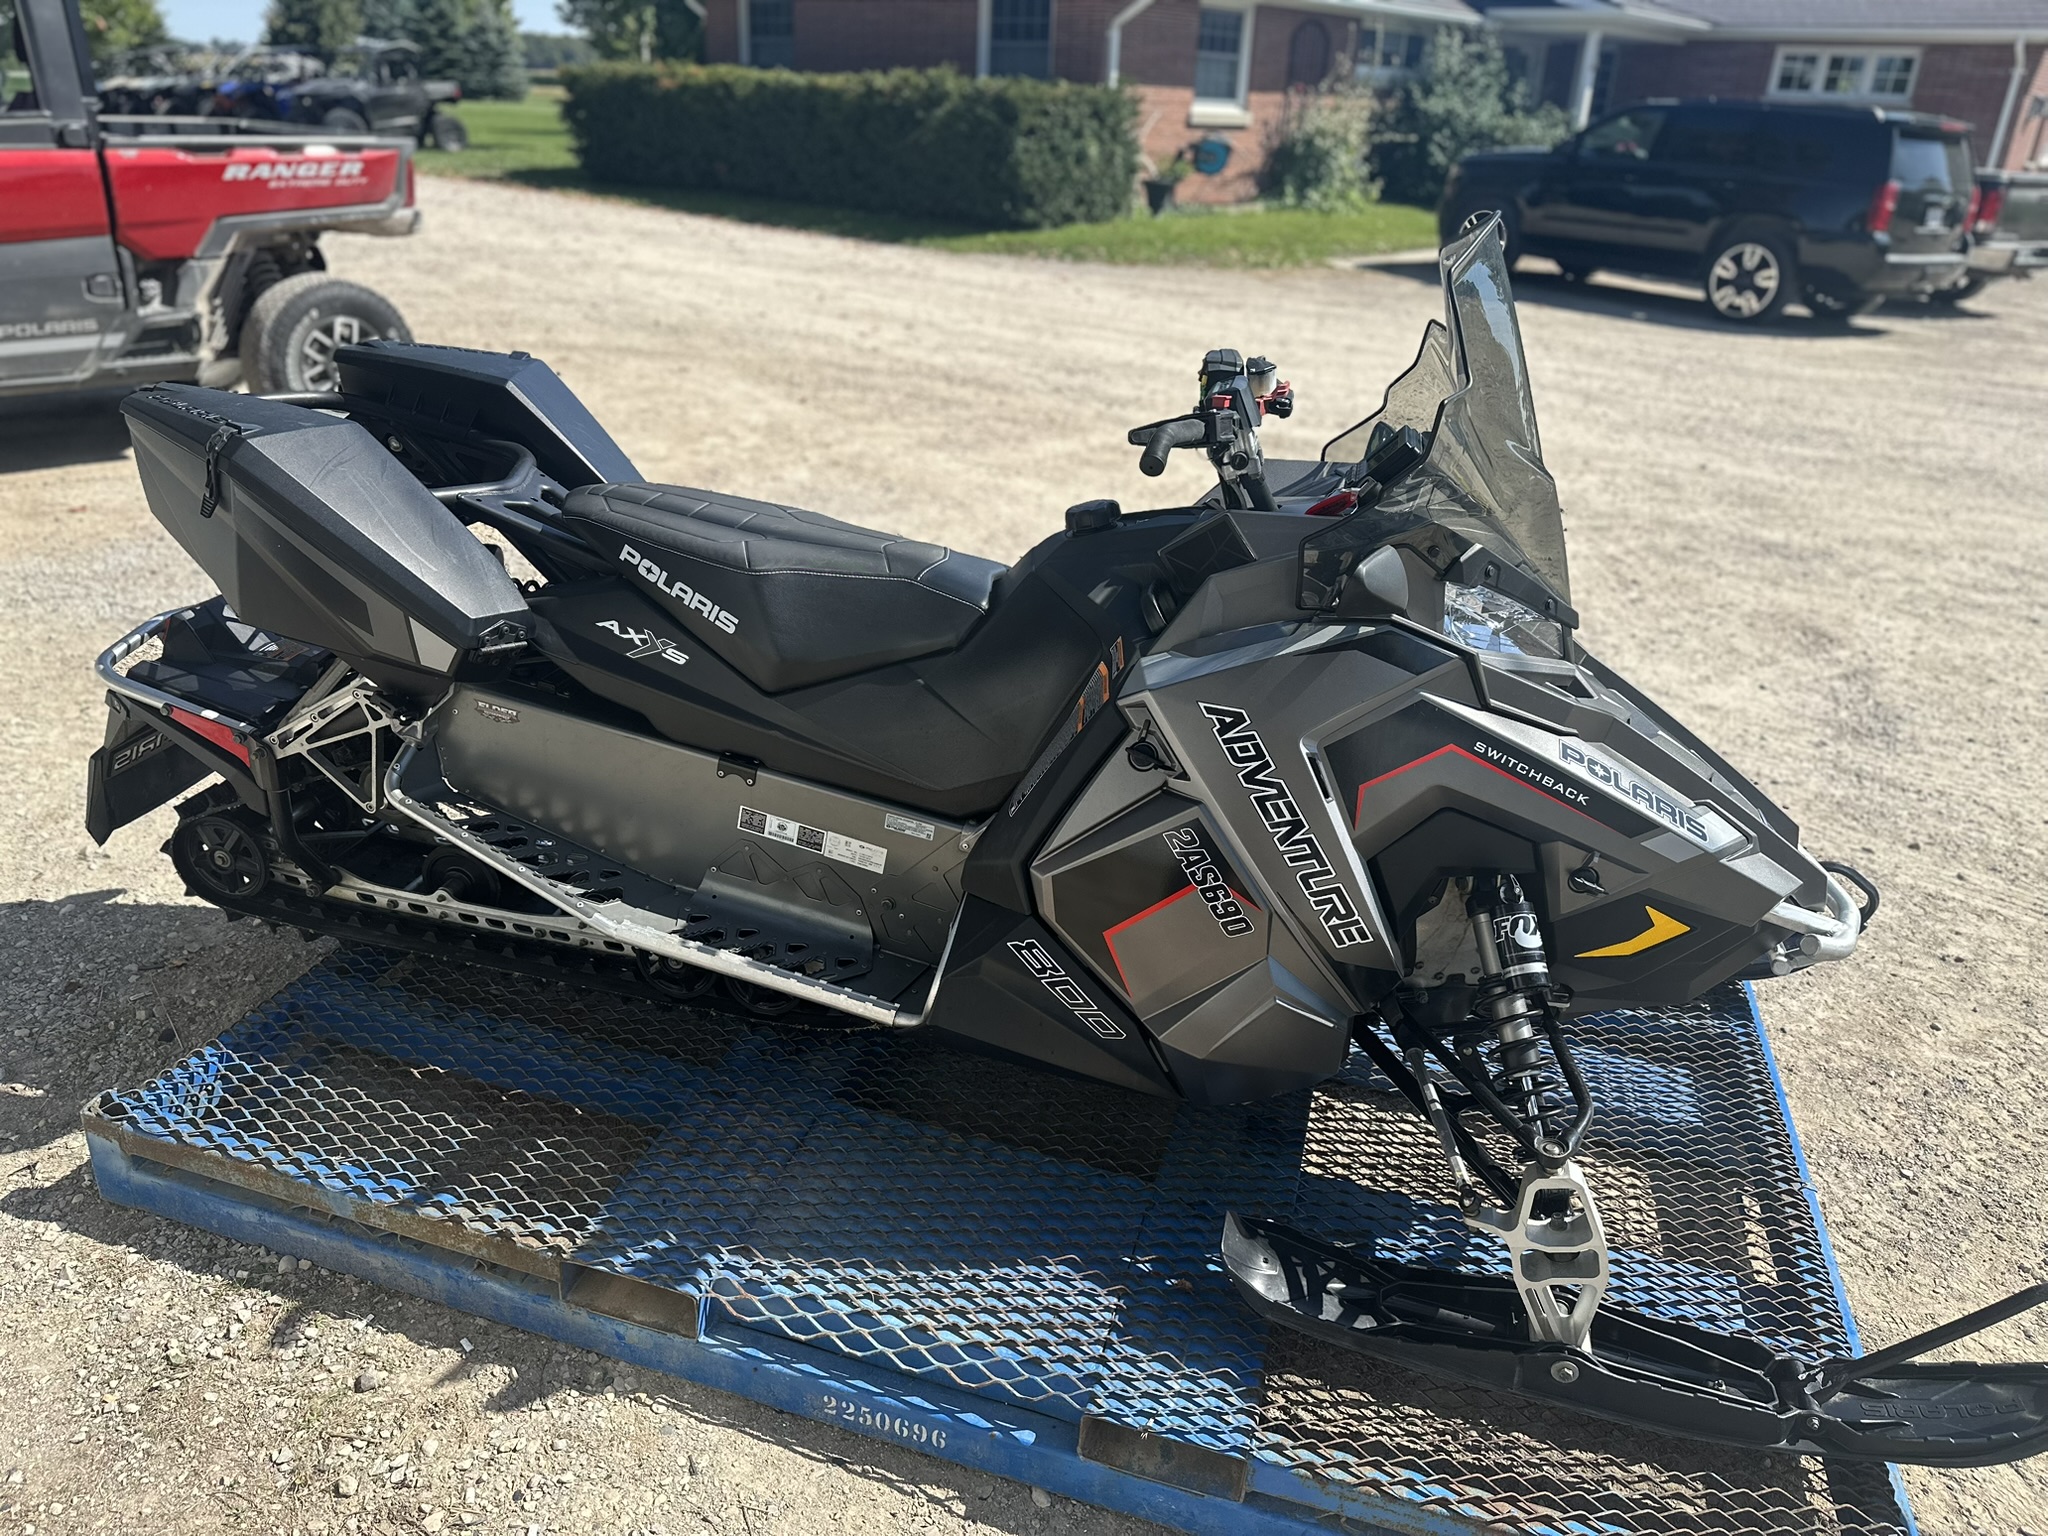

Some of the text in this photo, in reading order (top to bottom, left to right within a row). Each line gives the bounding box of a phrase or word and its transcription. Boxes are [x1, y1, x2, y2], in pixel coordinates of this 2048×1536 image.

[222, 161, 365, 182] RANGER
[0, 317, 99, 339] POLARIS
[618, 543, 740, 635] POLARIS
[595, 619, 690, 665] AXYS
[1473, 741, 1590, 807] SWITCHBACK
[1558, 738, 1710, 843] POLARIS
[1197, 700, 1374, 948] ADVENTURE
[1162, 827, 1255, 938] 2AS690
[1493, 913, 1541, 945] FOX
[1006, 938, 1127, 1040] 800
[823, 1394, 947, 1449] 2250696
[1859, 1397, 2026, 1420] POLARIS
